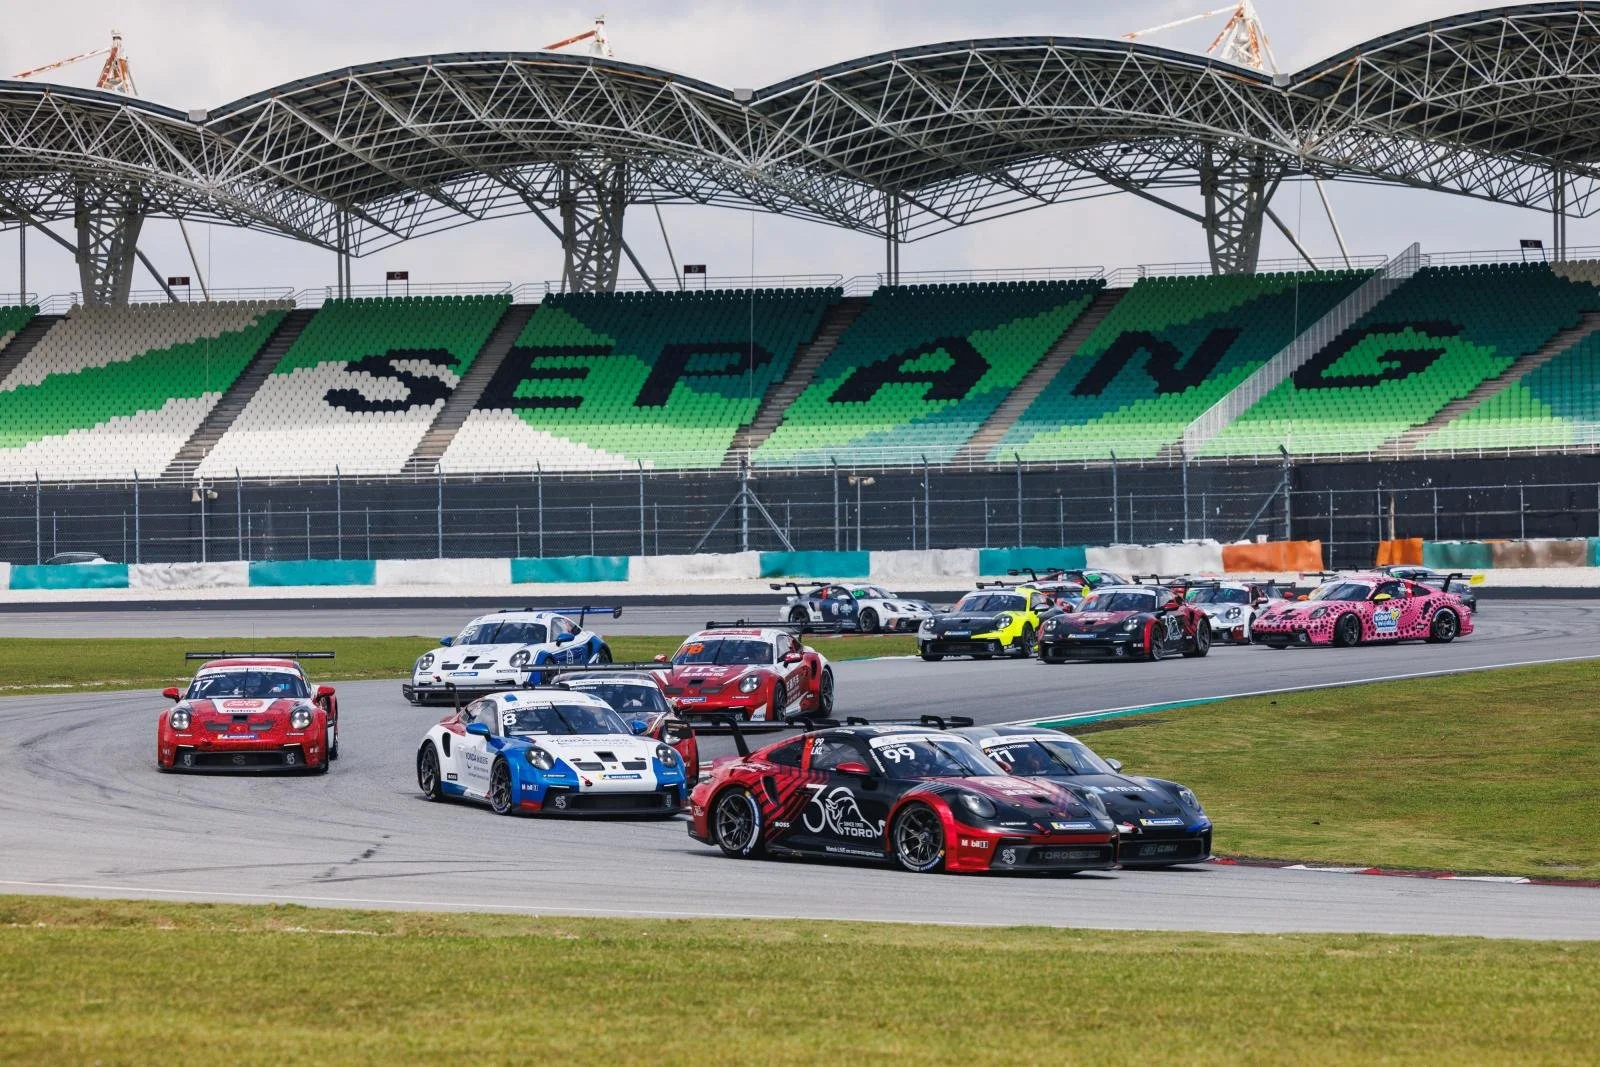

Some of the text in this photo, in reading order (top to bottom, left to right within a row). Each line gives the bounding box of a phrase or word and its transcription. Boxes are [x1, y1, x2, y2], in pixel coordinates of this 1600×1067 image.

[322, 320, 1466, 413] SEPANG
[193, 680, 214, 692] 17
[503, 713, 517, 726] 8
[814, 737, 825, 747] 99
[883, 746, 915, 764] 99
[843, 827, 873, 838] TORO
